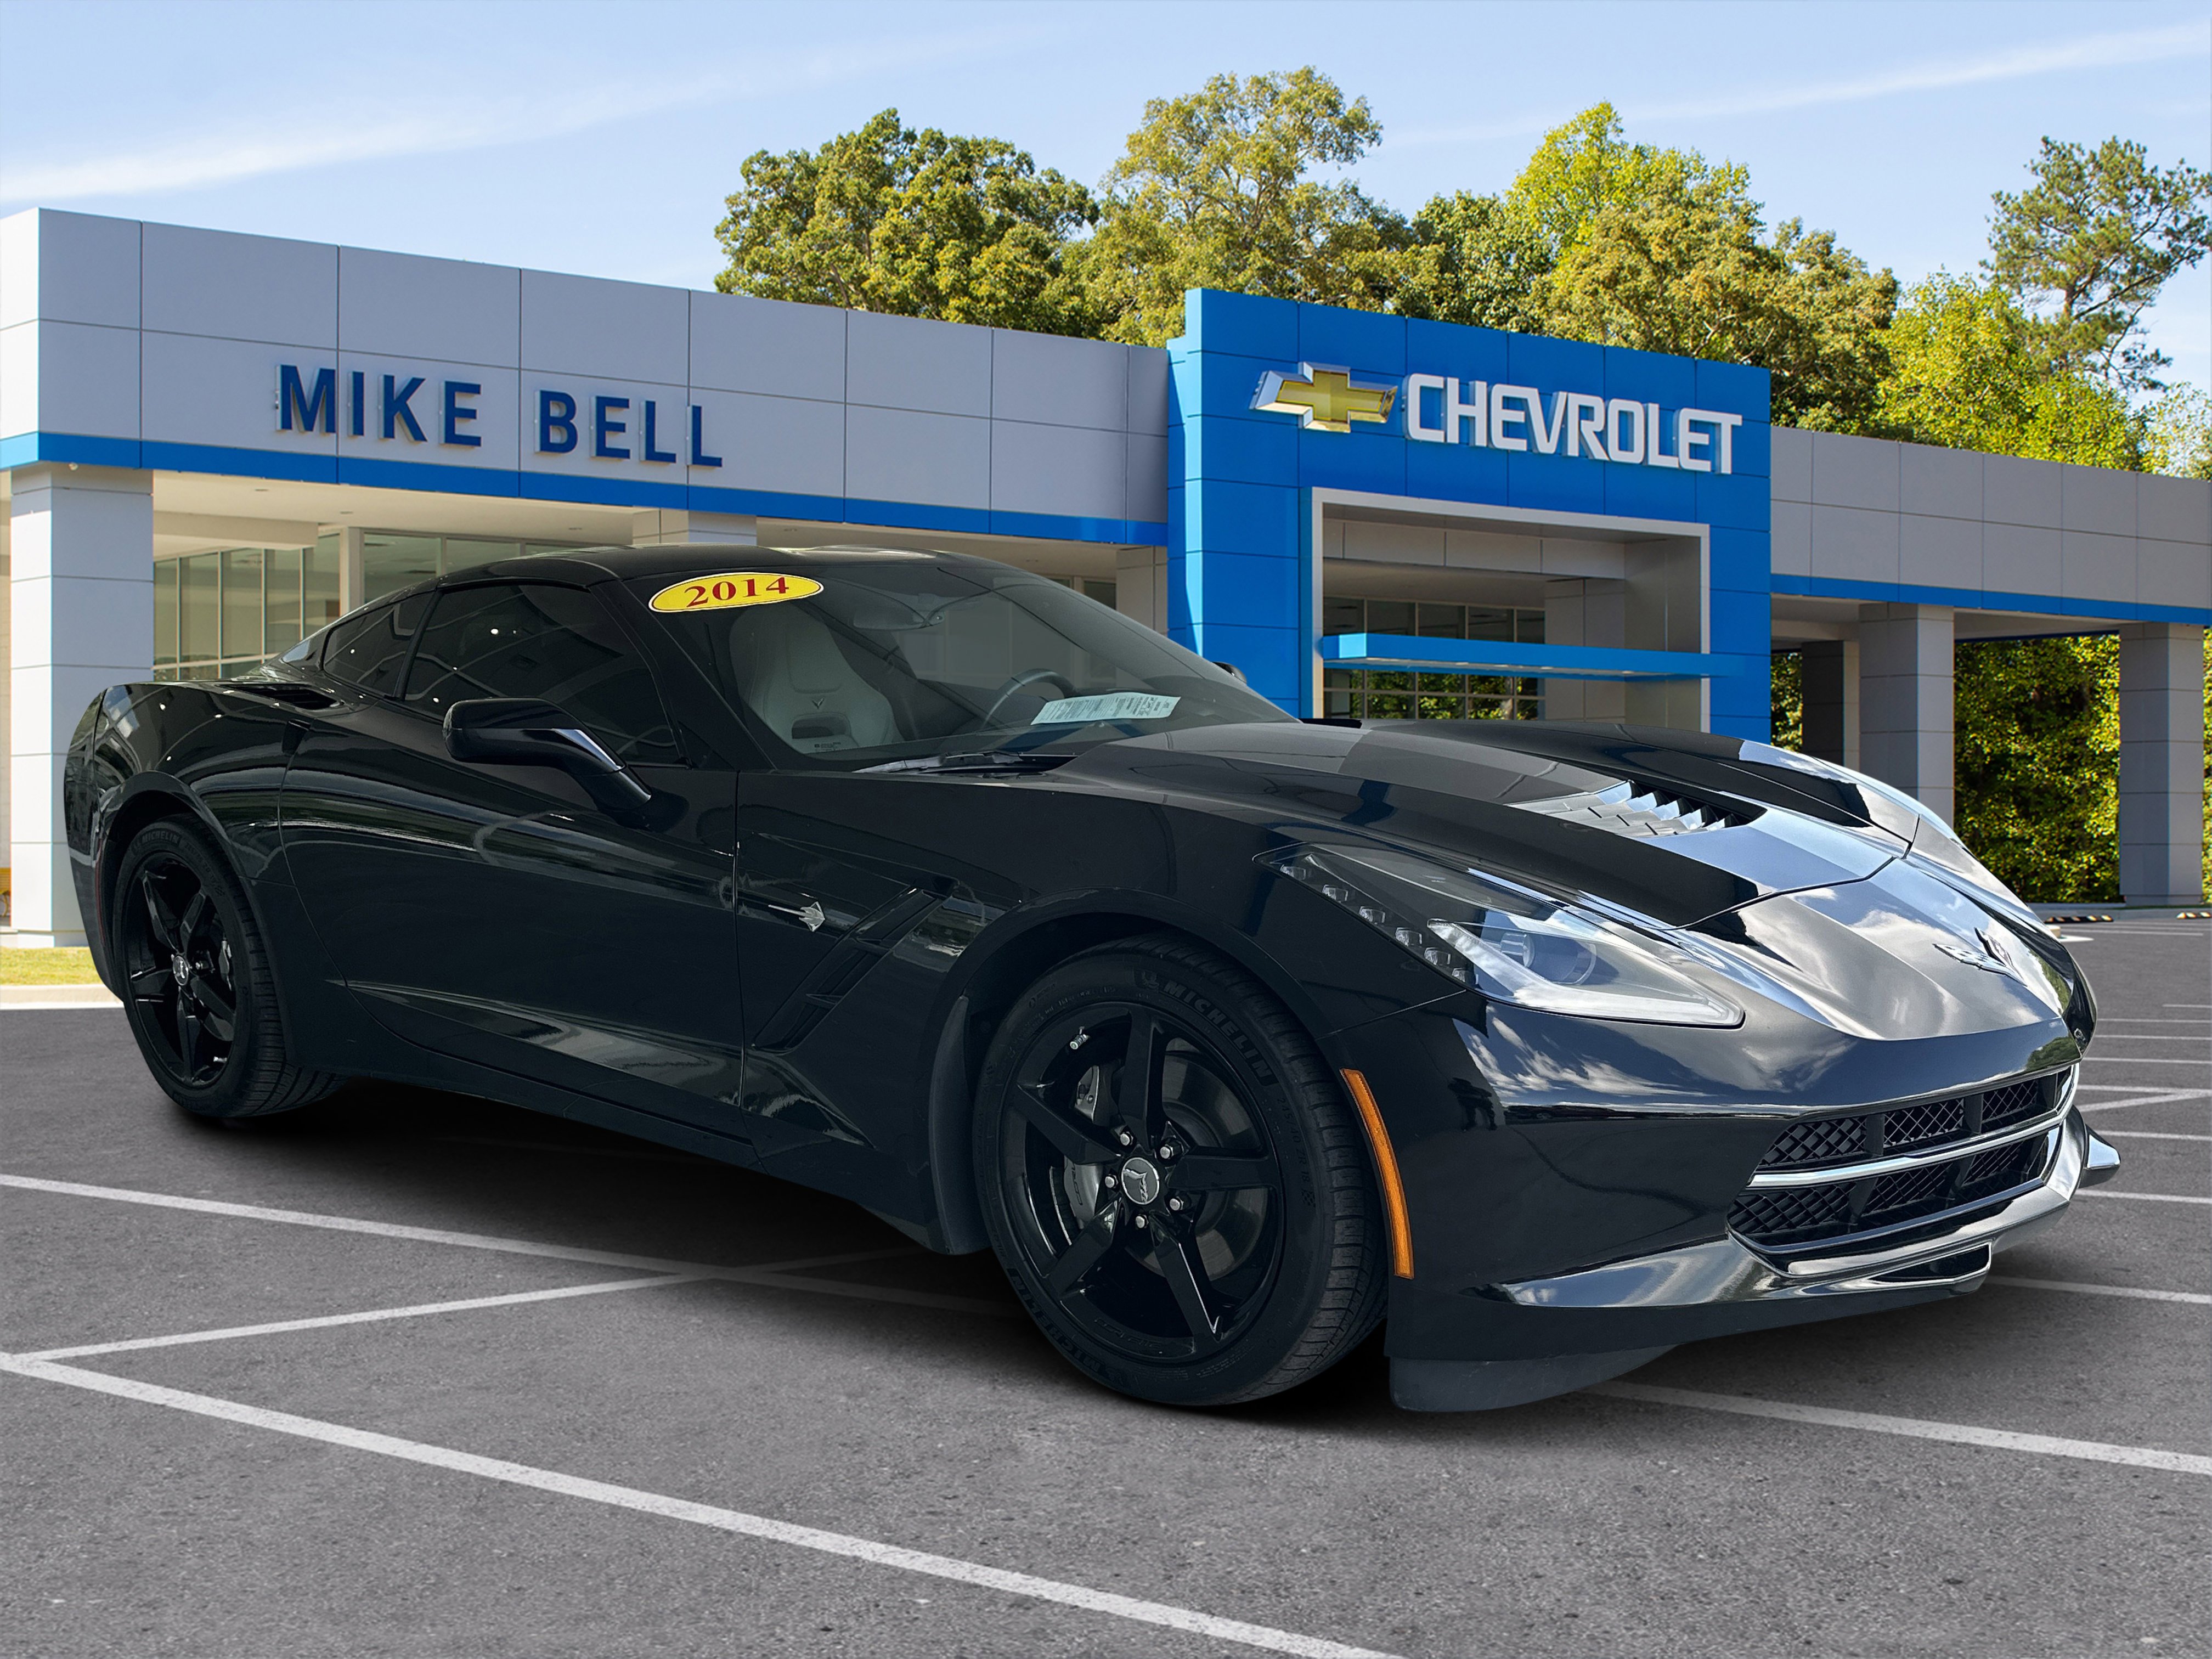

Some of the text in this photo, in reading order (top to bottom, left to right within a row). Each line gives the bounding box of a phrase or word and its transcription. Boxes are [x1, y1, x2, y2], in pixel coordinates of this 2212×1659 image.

[279, 364, 723, 467] MIKE BELL
[1405, 373, 1742, 475] CHEVROLET
[684, 577, 789, 608] 2014
[142, 830, 180, 845] MICHELIN
[1163, 980, 1273, 1077] MICHELIN
[1011, 1275, 1100, 1372] MICHELIN
